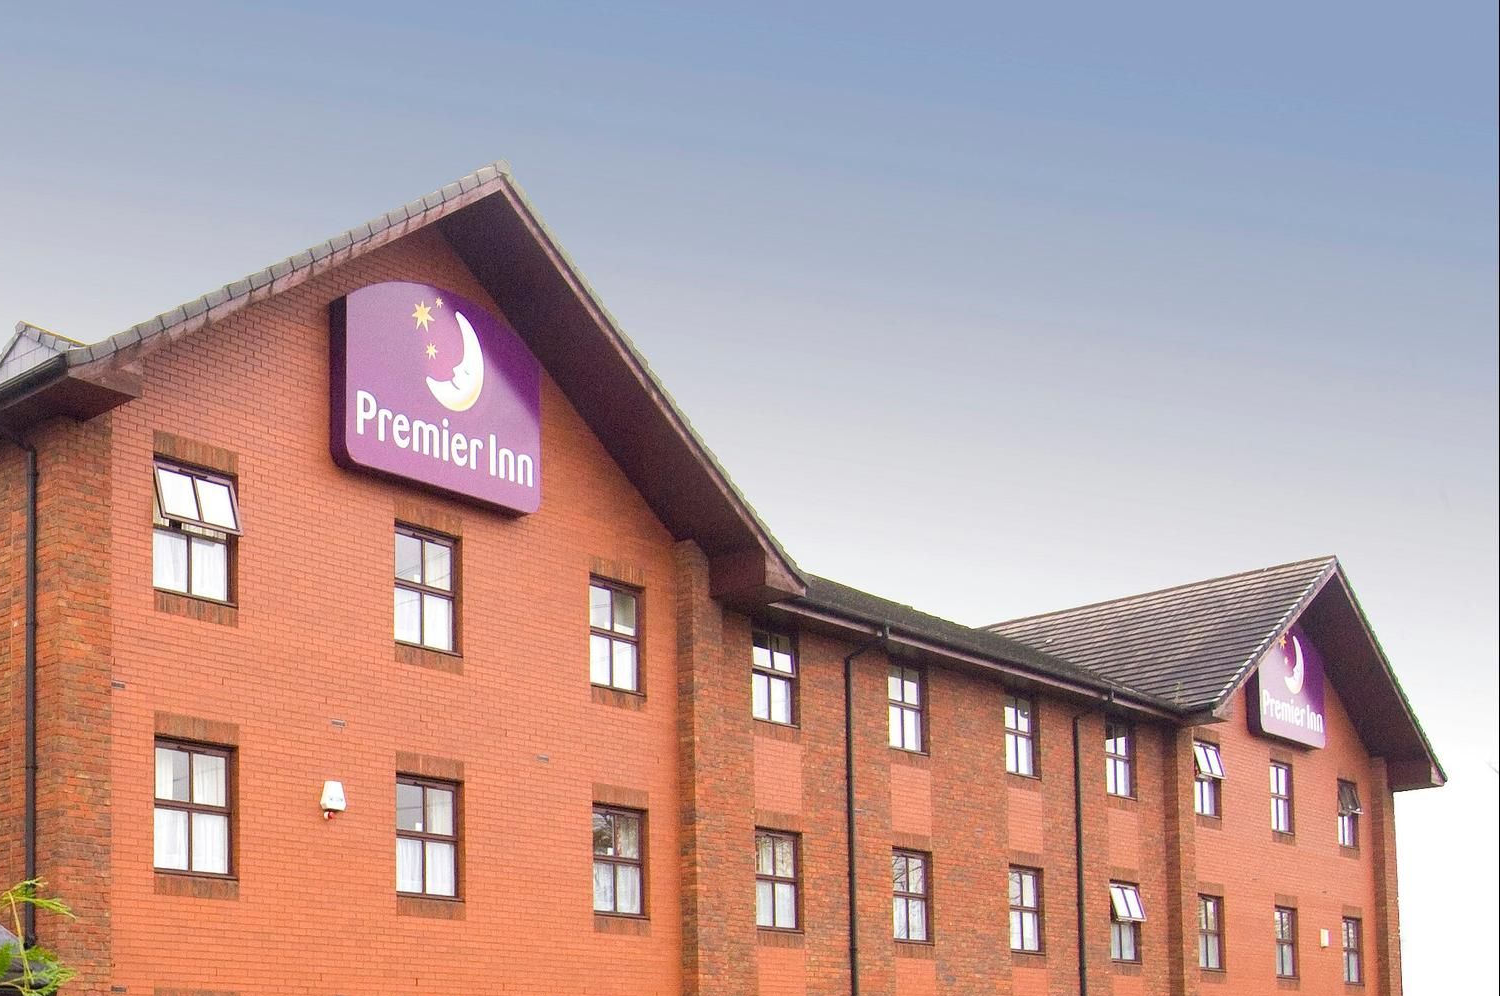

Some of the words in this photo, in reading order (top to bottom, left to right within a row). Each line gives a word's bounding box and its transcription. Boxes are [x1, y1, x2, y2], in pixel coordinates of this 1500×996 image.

[356, 390, 484, 471] Premier
[489, 434, 534, 488] Inn
[1262, 689, 1306, 728] Premier
[1307, 704, 1324, 733] Inn
